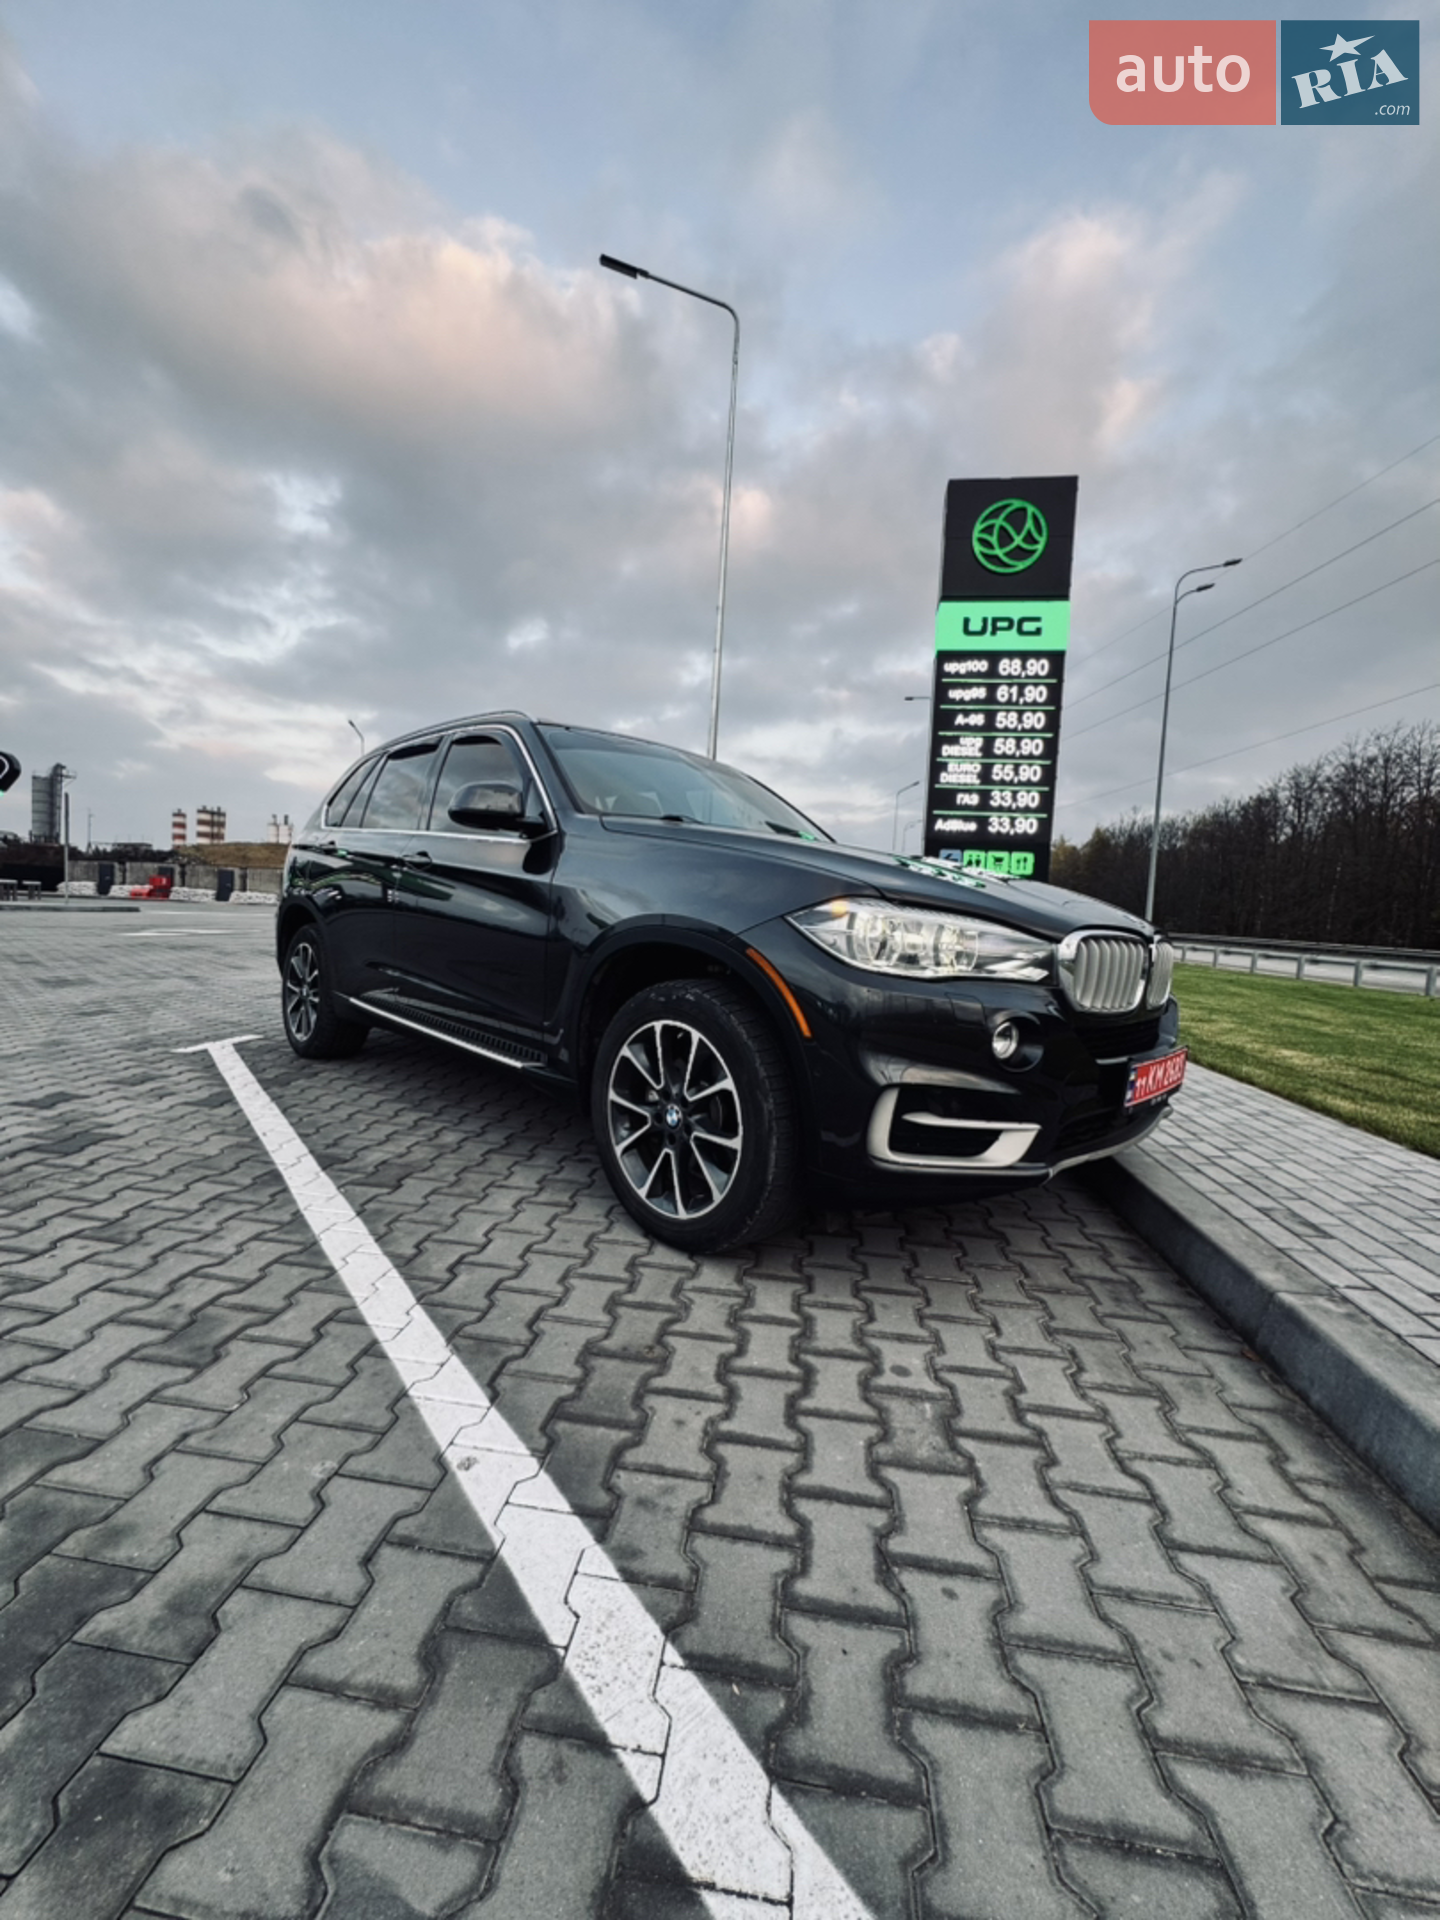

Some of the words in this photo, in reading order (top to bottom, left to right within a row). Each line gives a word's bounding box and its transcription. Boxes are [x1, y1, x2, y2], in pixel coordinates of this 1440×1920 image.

[962, 616, 1042, 637] UPG
[943, 660, 988, 674] upg100
[998, 658, 1049, 678] 68,90
[996, 685, 1047, 704] 61,90
[995, 711, 1045, 730] 58,90
[993, 738, 1043, 757] 58,90
[991, 764, 1041, 783] 55,90
[990, 791, 1040, 809] 33,90
[988, 817, 1038, 835] 33,90
